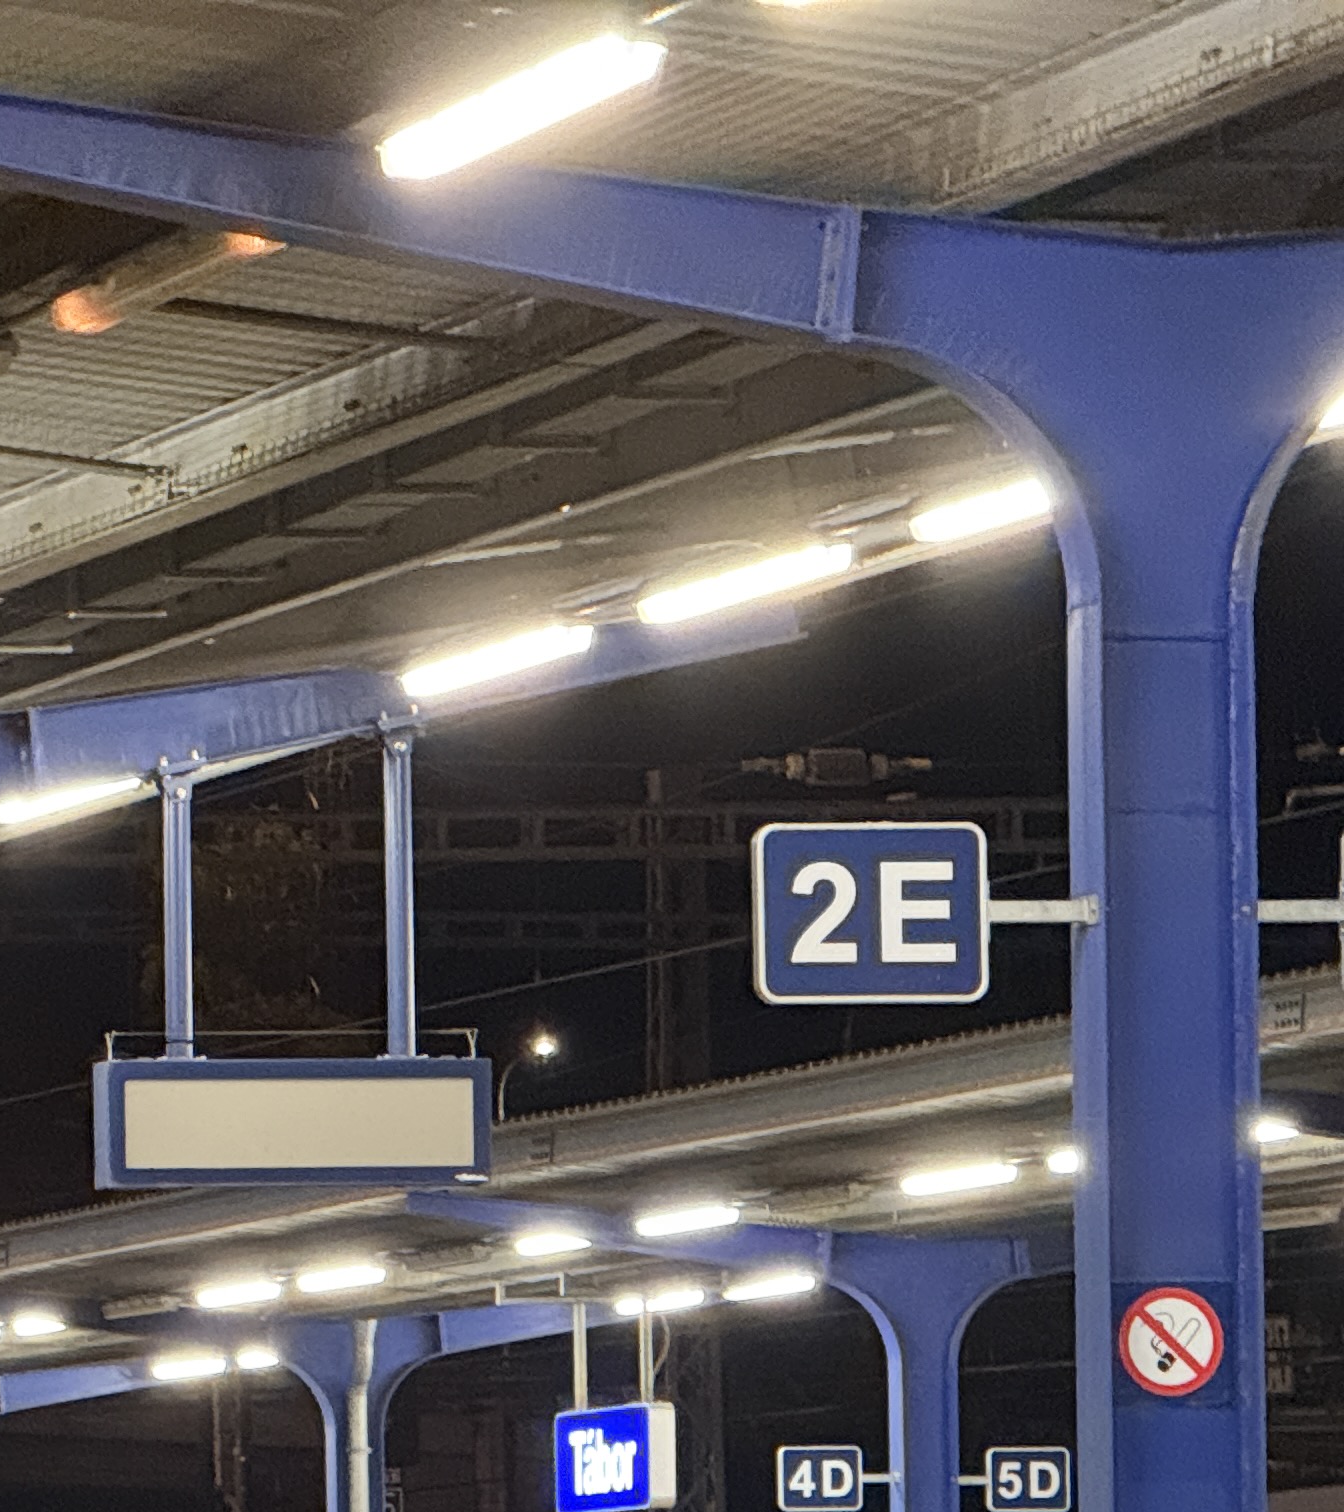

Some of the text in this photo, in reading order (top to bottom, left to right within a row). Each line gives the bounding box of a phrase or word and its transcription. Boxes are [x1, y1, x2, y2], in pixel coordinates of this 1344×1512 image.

[790, 860, 958, 964] 2E
[568, 1428, 637, 1496] Tábor
[788, 1459, 854, 1498] 4D
[998, 1461, 1061, 1499] 5D
